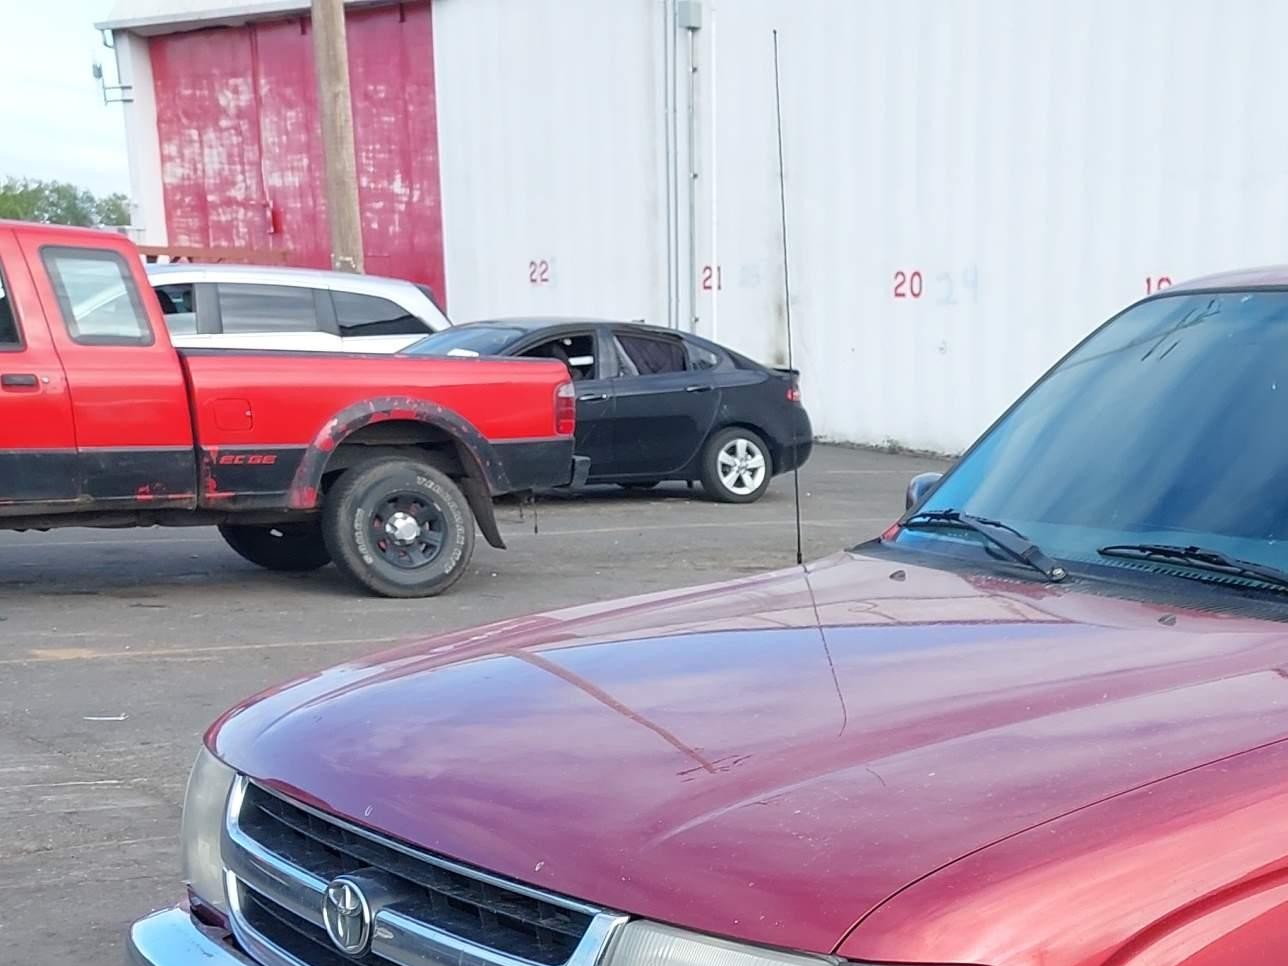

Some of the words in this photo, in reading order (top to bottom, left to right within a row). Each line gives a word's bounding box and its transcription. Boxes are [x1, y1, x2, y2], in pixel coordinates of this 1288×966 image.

[529, 260, 549, 283] 22
[702, 265, 722, 291] 21
[894, 271, 923, 298] 20
